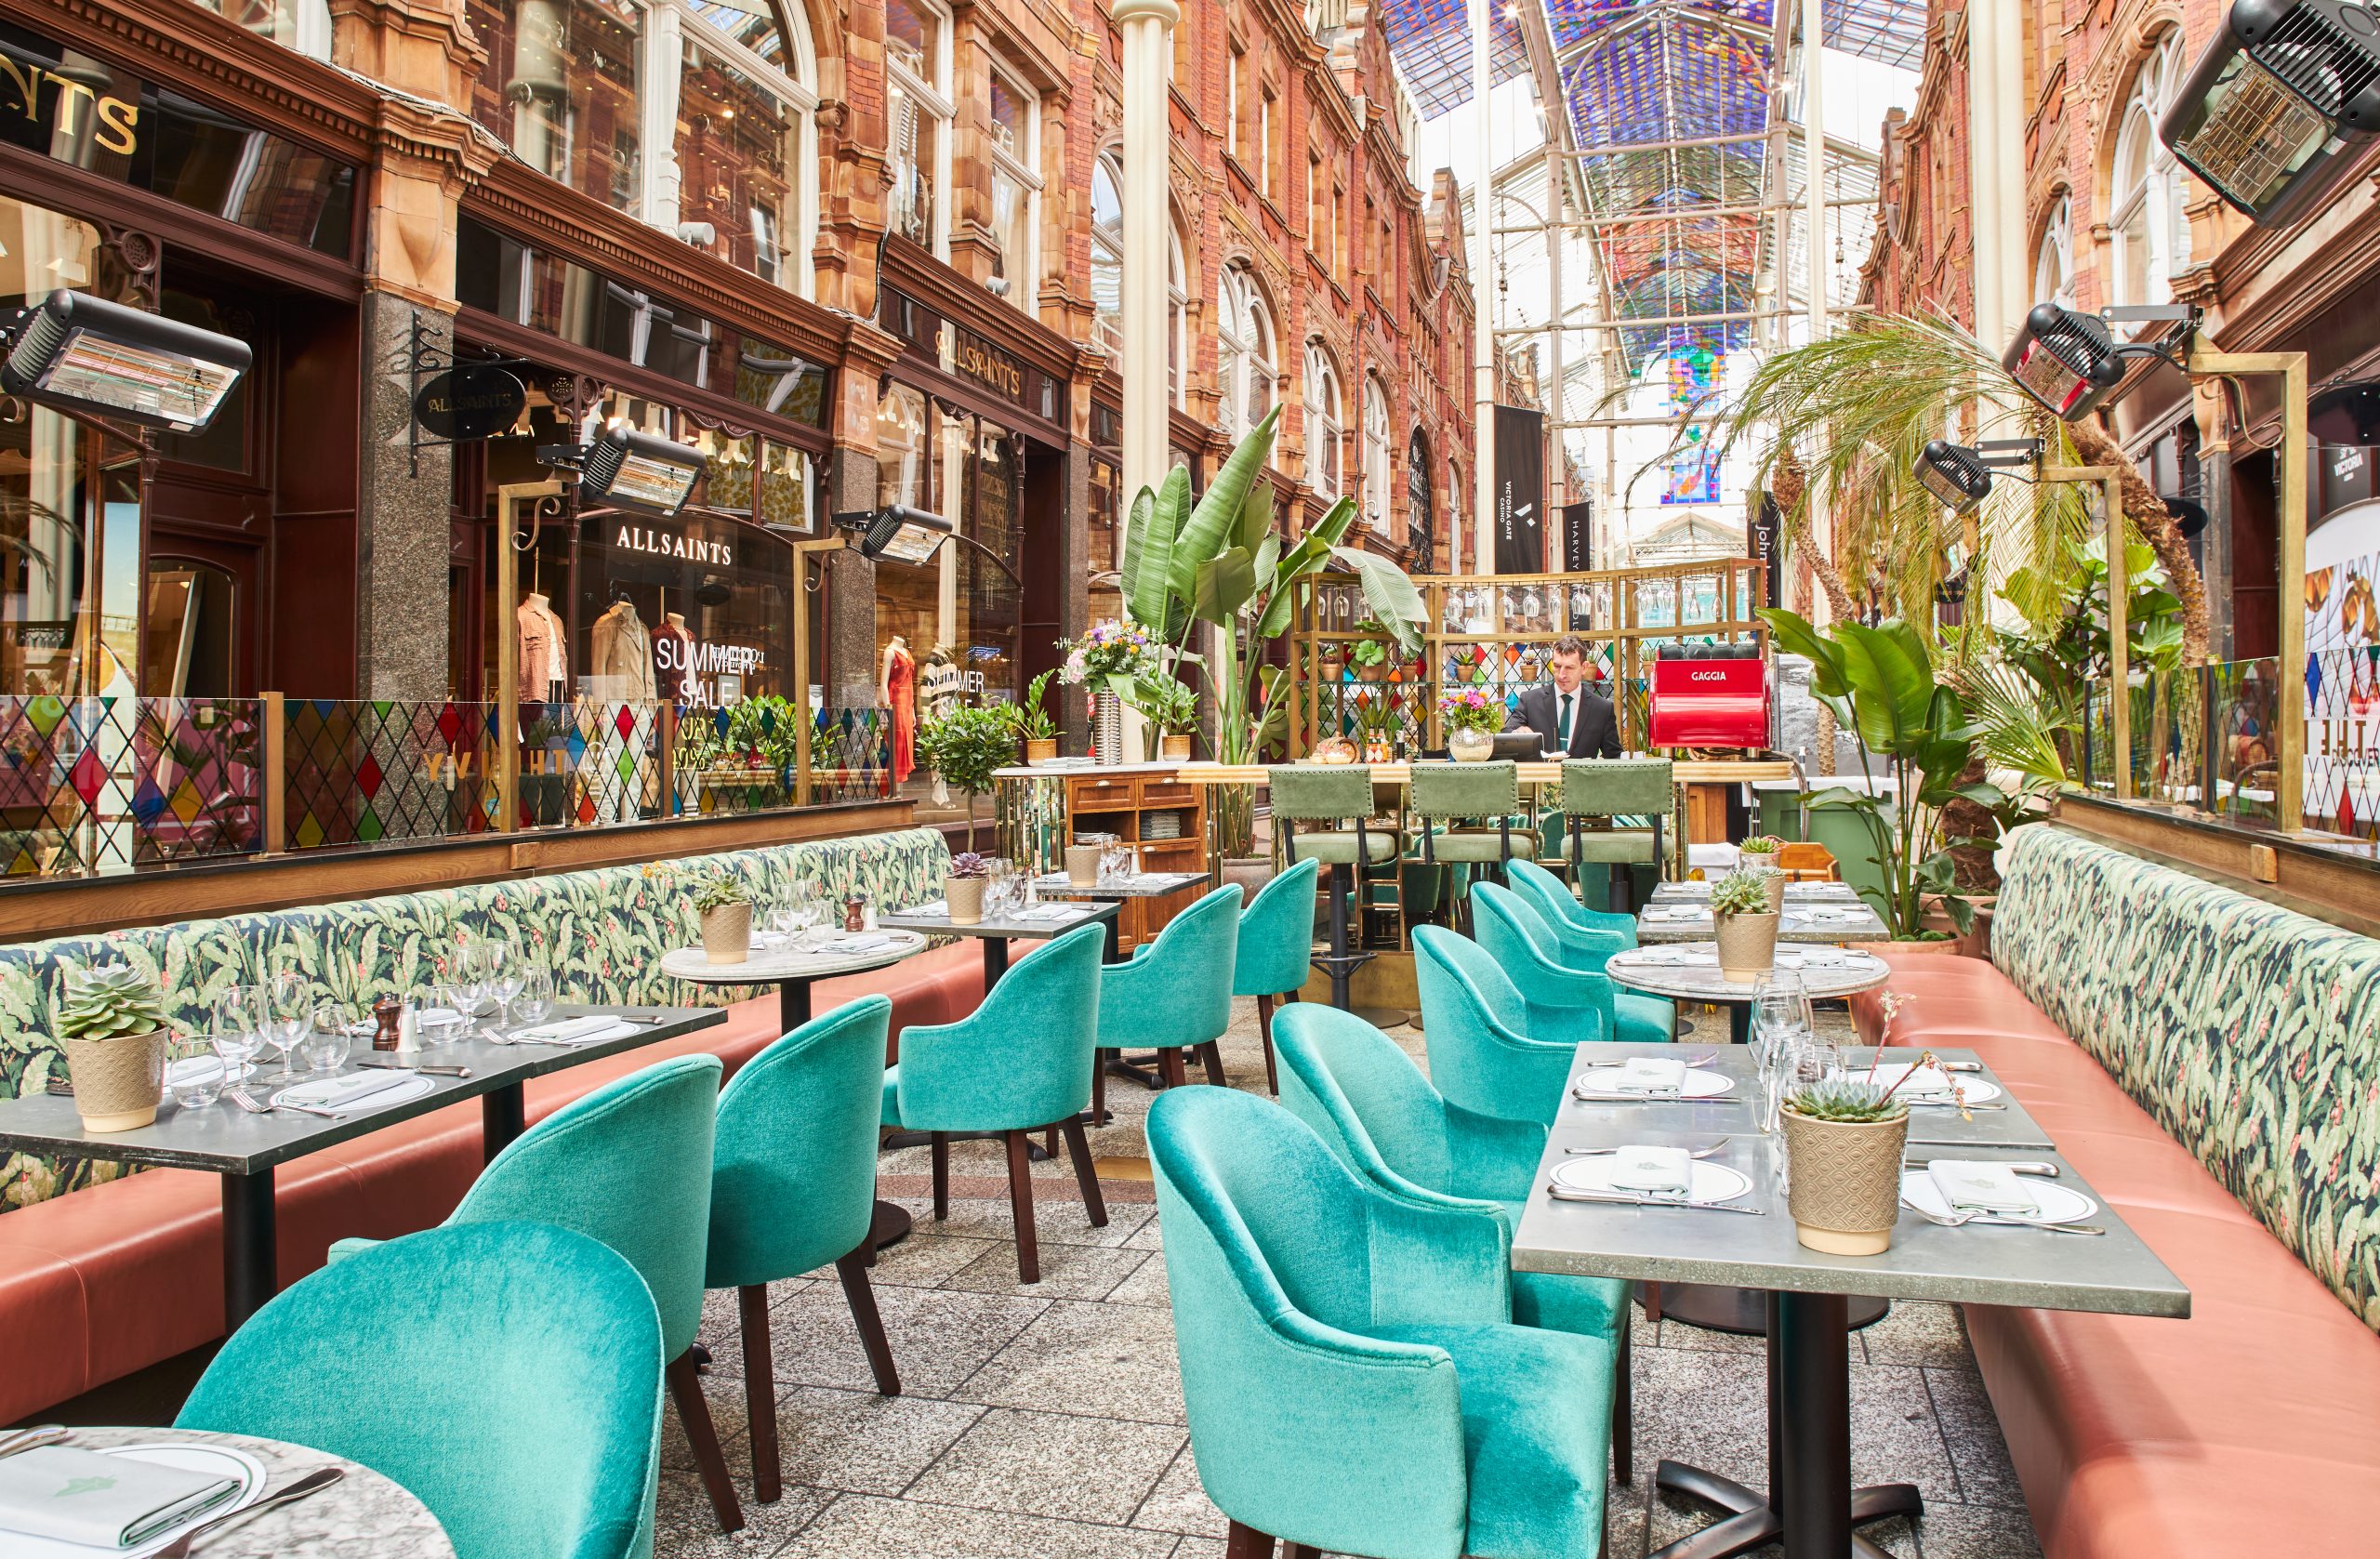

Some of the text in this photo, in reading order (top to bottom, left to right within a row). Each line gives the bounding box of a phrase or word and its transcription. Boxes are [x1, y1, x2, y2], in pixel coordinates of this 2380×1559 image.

[935, 330, 1020, 395] ALLSAINTS
[2334, 453, 2363, 477] VICTORIA
[616, 525, 732, 566] ALLSAINTS
[1755, 523, 1771, 561] John
[656, 638, 754, 676] SUMMER
[927, 667, 985, 694] SUMMER
[1690, 671, 1726, 681] GAGGIA
[679, 679, 734, 710] SALE
